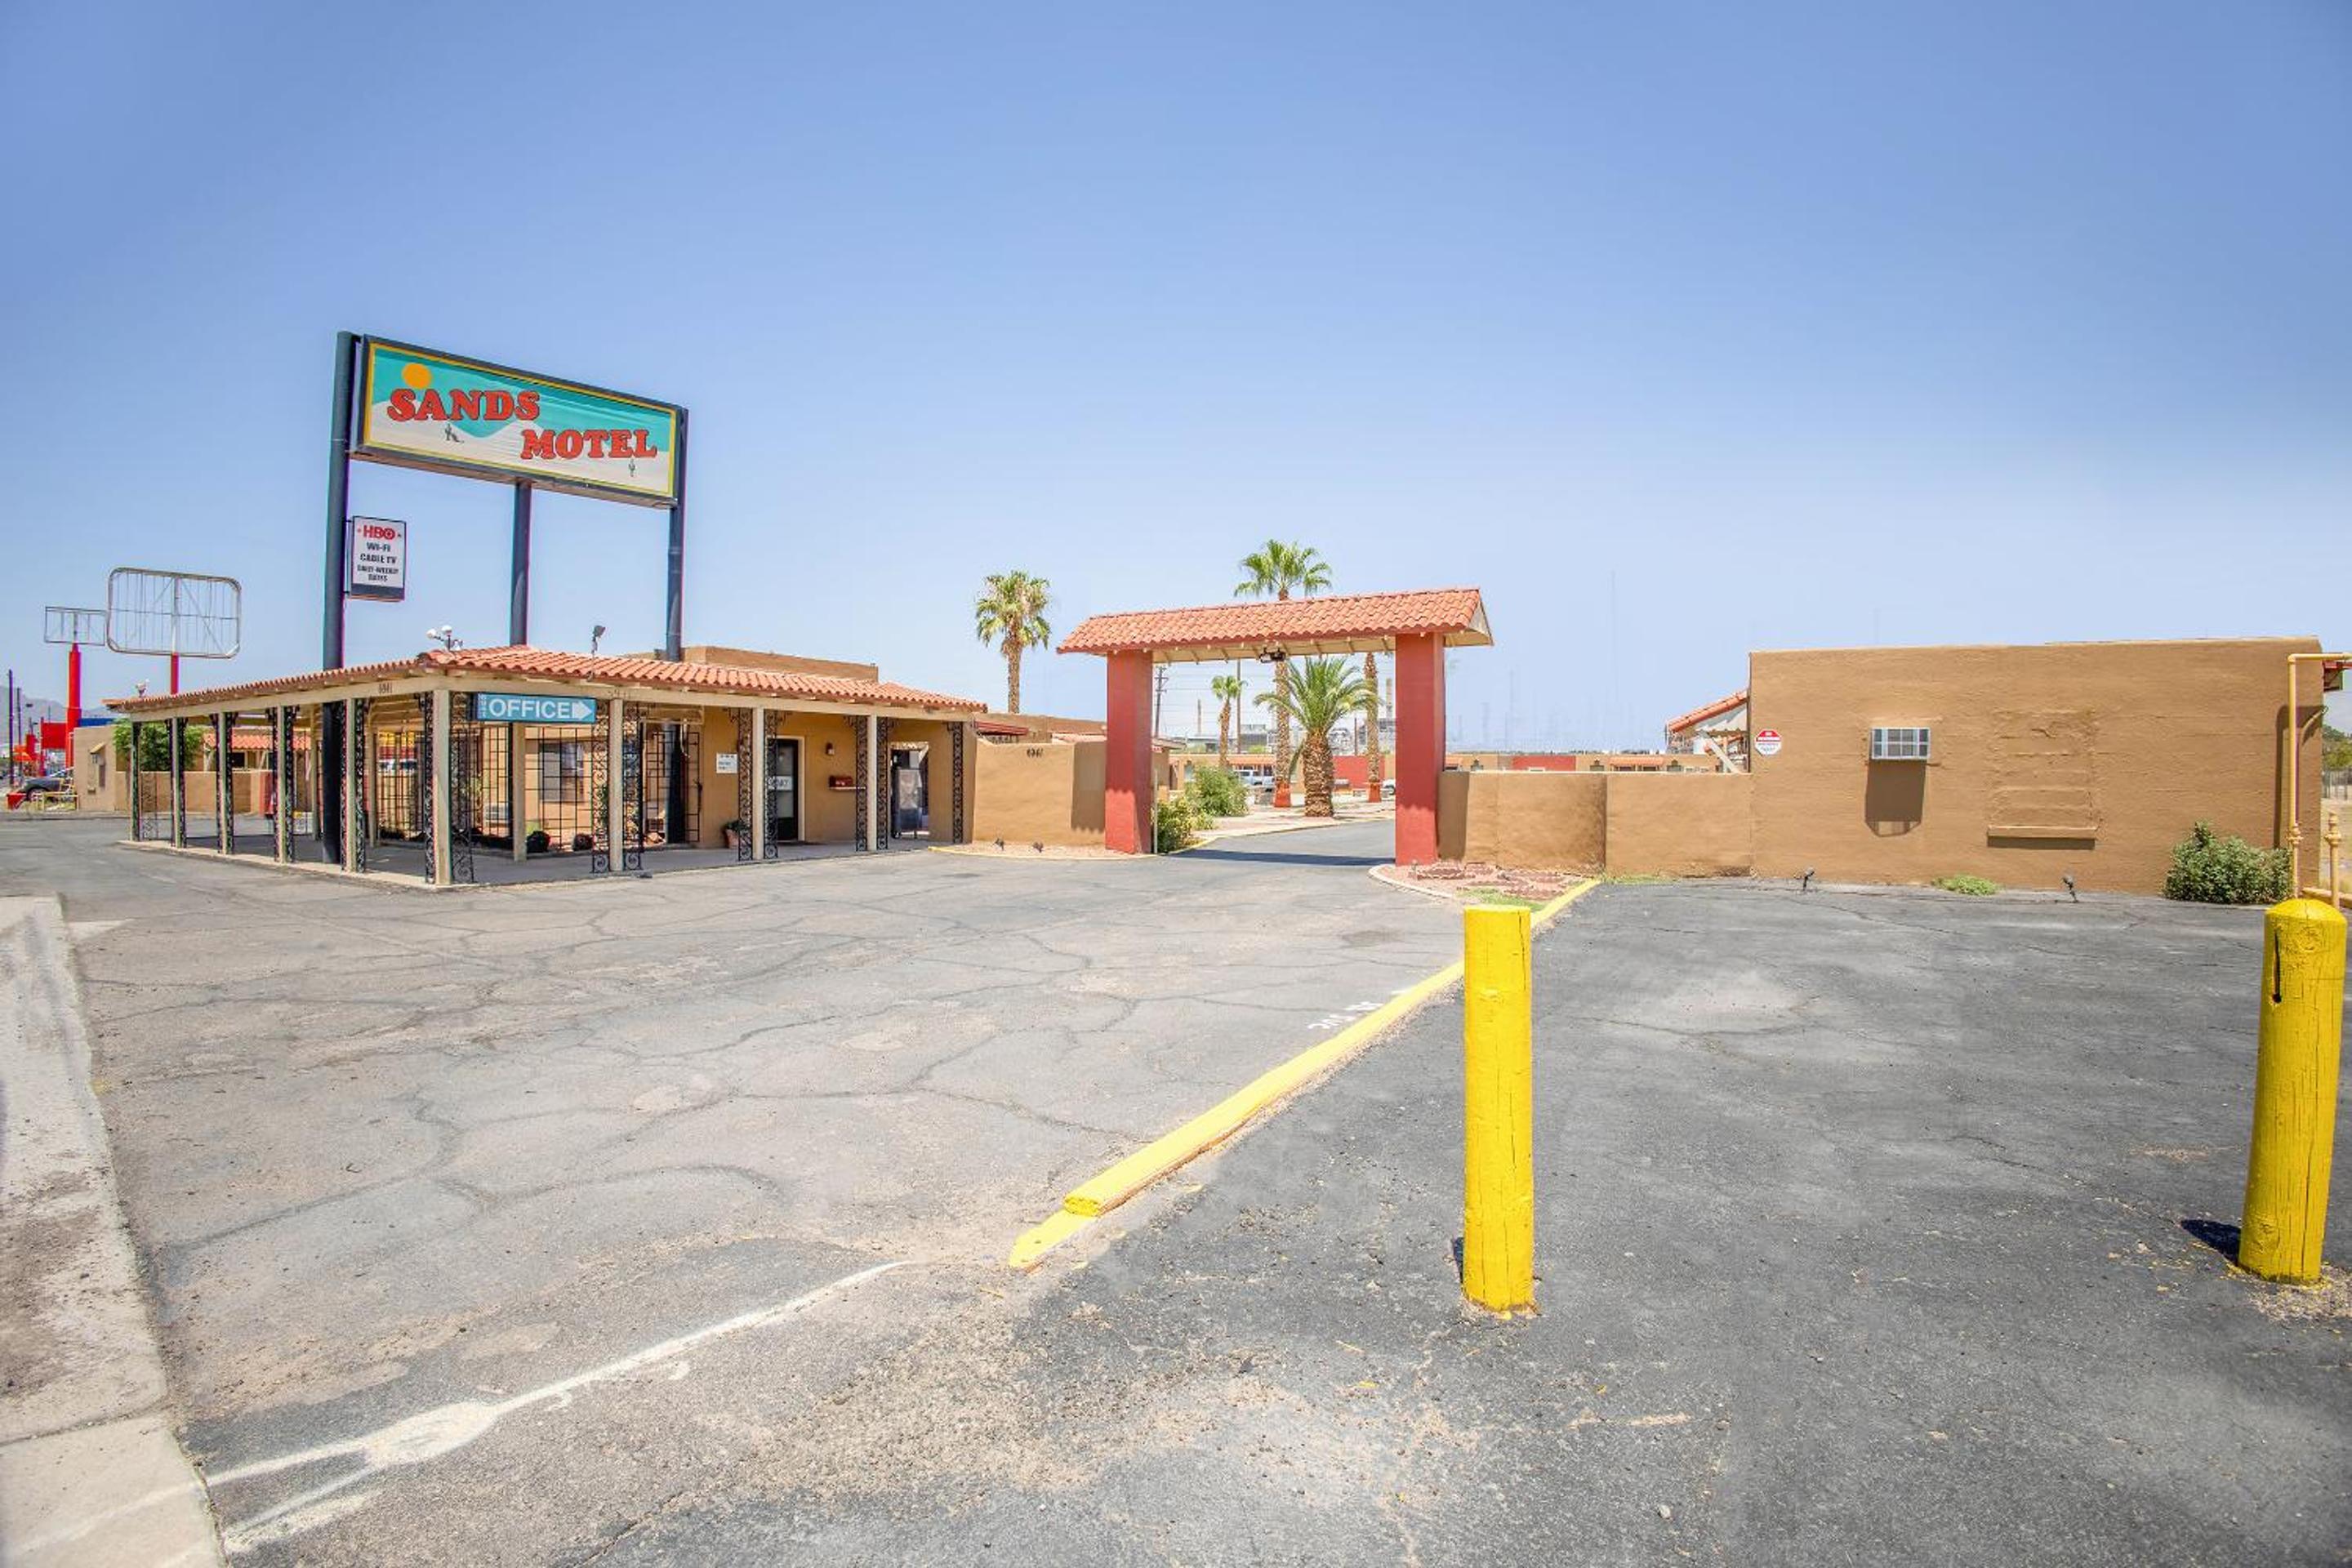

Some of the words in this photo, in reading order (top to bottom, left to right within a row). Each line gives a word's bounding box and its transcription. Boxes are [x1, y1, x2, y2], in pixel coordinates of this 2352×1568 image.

[387, 389, 540, 421] SANDS
[520, 429, 657, 460] MOTEL
[363, 525, 395, 540] HBO
[488, 698, 570, 719] OFFICE
